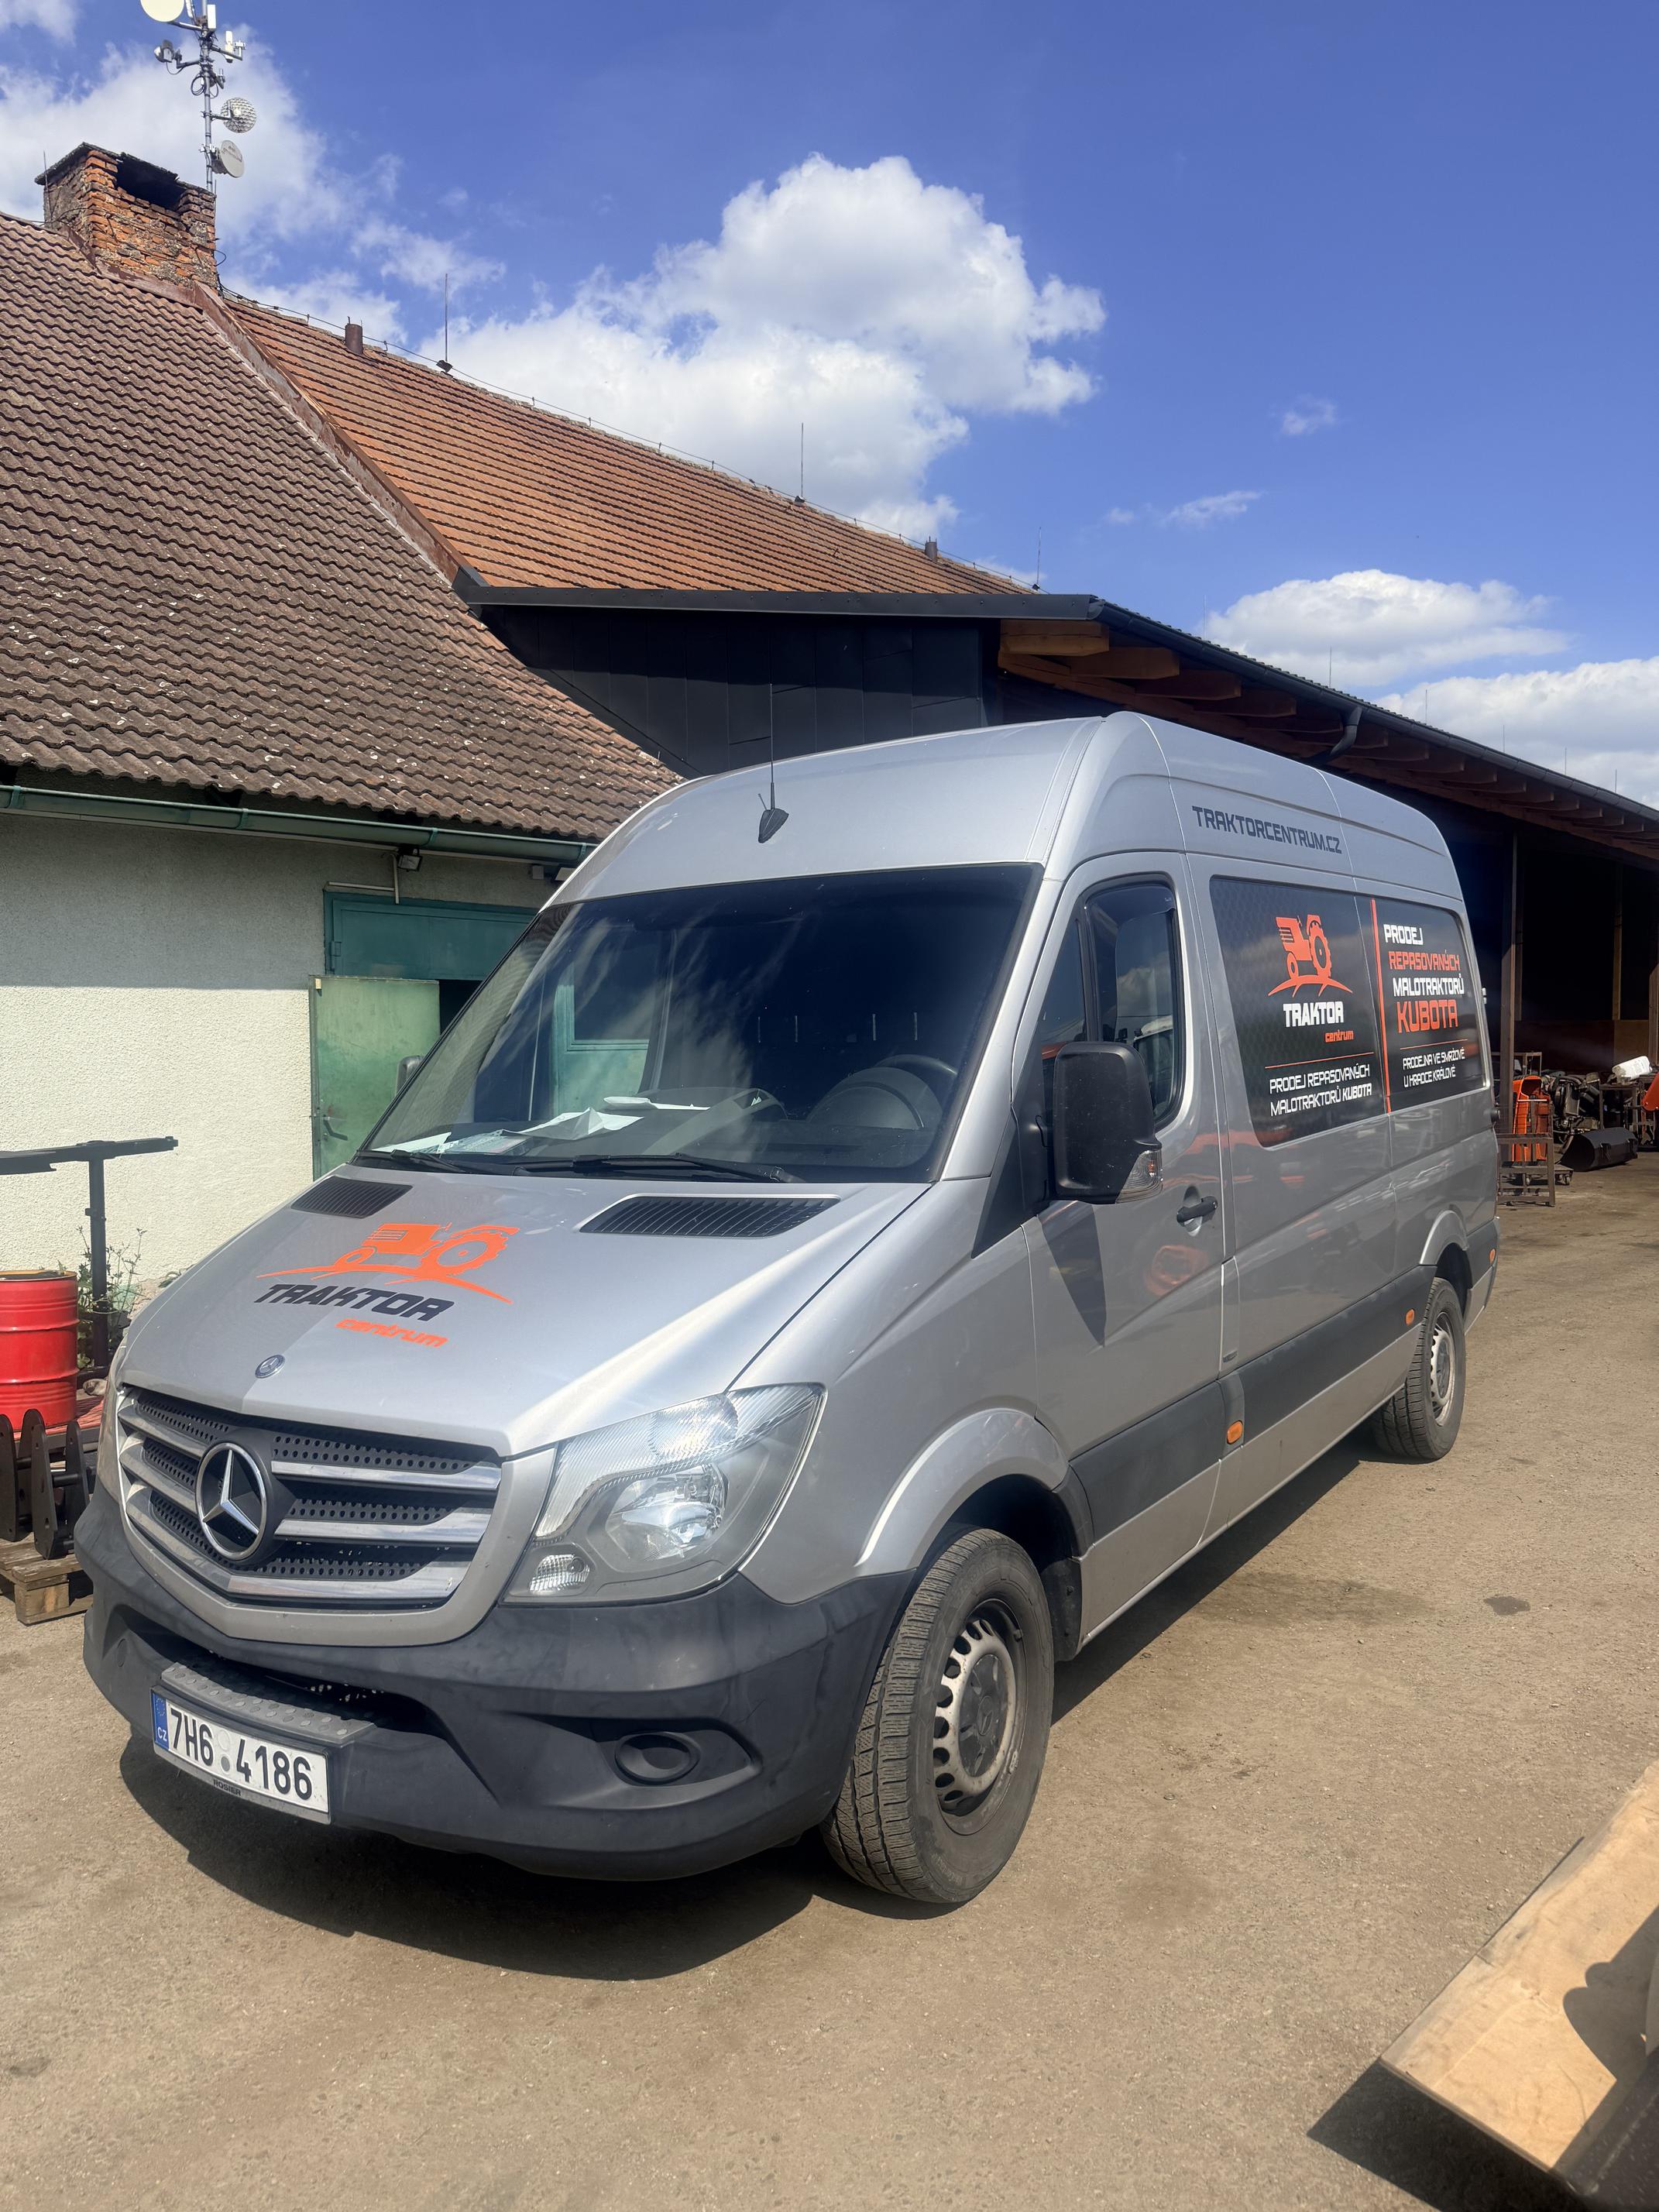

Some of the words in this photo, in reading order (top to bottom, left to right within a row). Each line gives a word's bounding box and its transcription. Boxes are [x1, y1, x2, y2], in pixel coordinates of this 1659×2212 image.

[1192, 806, 1342, 854] TRAKTORCENTRUM.CZ
[1383, 924, 1424, 946] PRODEJ
[1388, 949, 1461, 971] REPASOVANÝCH
[1393, 973, 1465, 997] MALOTRAKTORŮ
[1283, 1001, 1345, 1028] TRAKTOR
[1396, 999, 1458, 1033] KUBOTA
[1324, 1029, 1354, 1042] centrum
[1403, 1053, 1433, 1070] PRODEJNA
[1433, 1052, 1441, 1064] VE
[1269, 1074, 1306, 1094] PRODEJ
[1307, 1063, 1370, 1087] REPASOVANÝCH
[1403, 1075, 1409, 1088] U
[1409, 1070, 1433, 1087] HRADCE
[1270, 1085, 1341, 1117] MALOTRAKTORŮ
[1342, 1083, 1372, 1101] KUBOTA
[253, 1283, 455, 1321] TRAKTOR
[334, 1317, 448, 1348] centrum
[157, 1726, 168, 1743] CZ
[170, 1706, 215, 1767] 7H6
[236, 1738, 313, 1801] 4186
